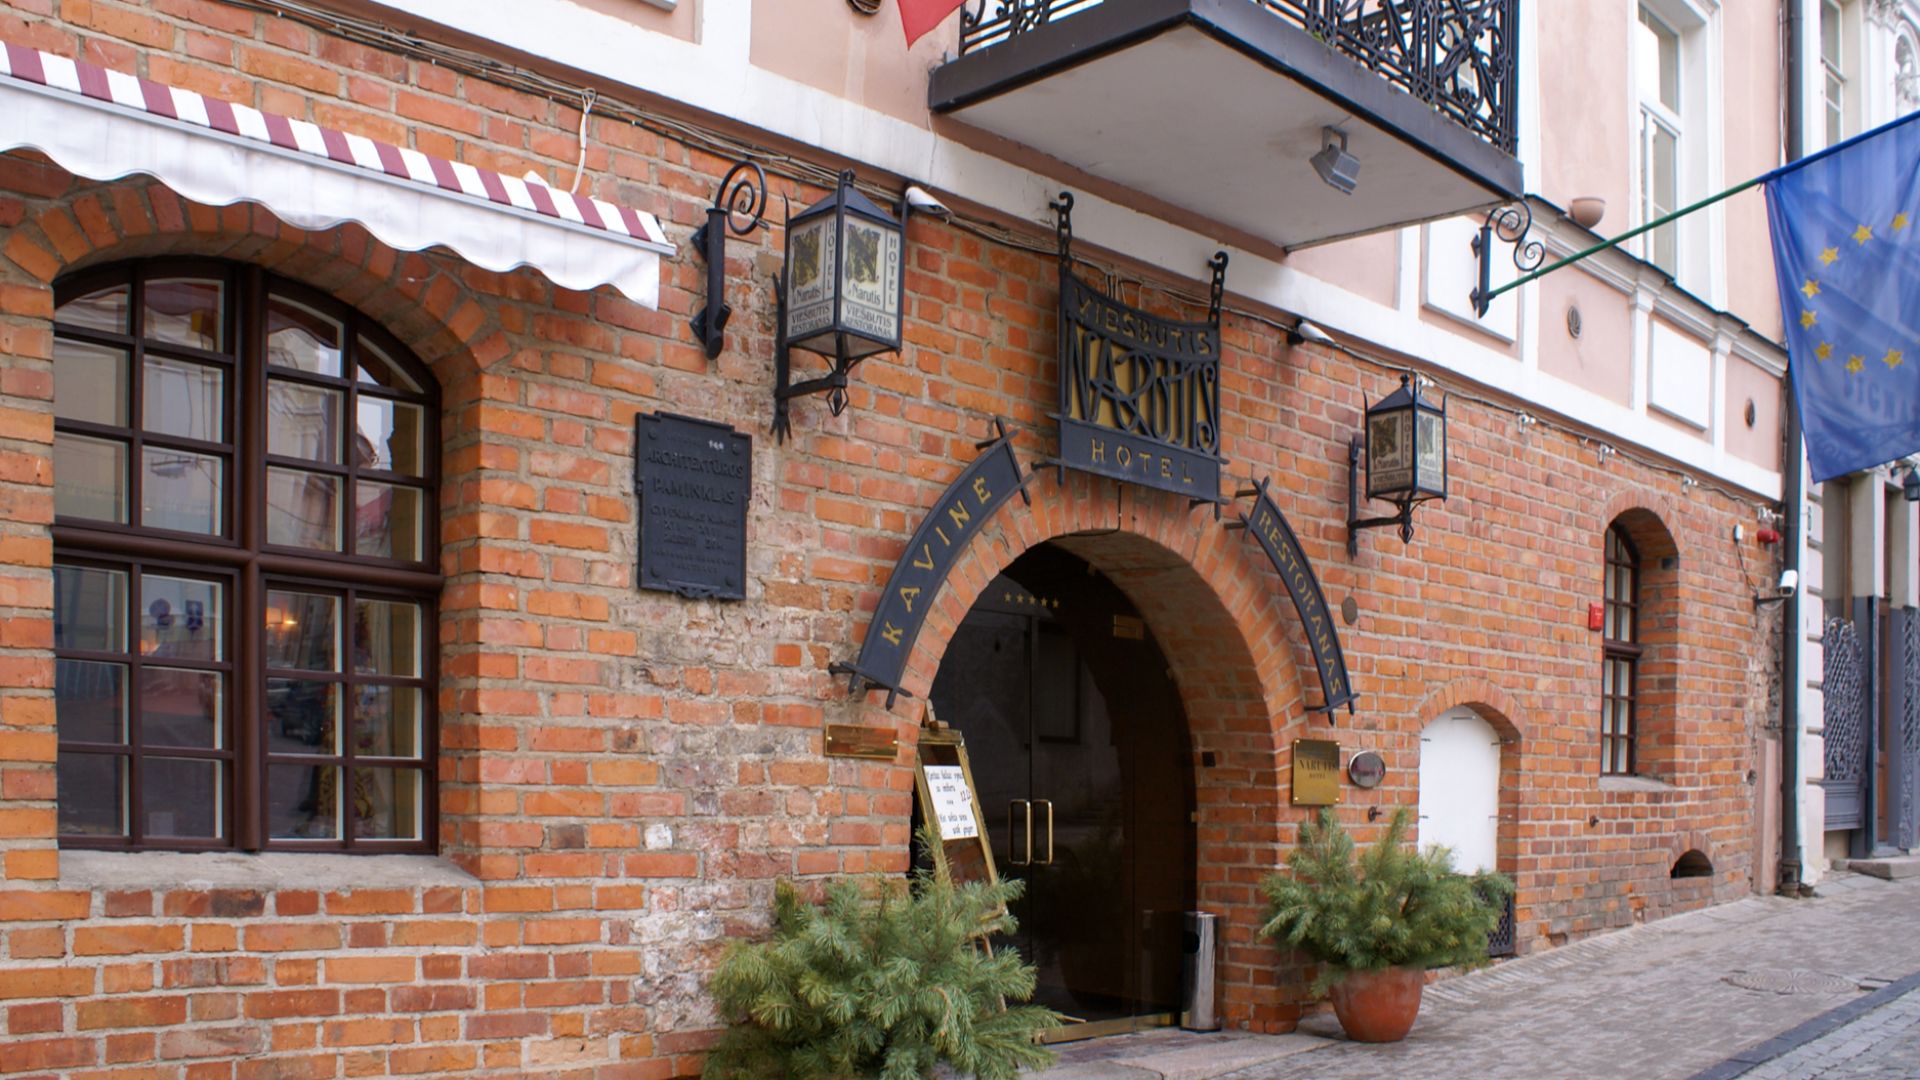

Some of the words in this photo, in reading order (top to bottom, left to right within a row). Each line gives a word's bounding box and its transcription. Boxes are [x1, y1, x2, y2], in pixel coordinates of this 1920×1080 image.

[852, 282, 881, 306] Narutis
[889, 237, 897, 305] HOTEL
[1091, 438, 1193, 483] HOTEL
[1258, 510, 1342, 696] RESTORANAS
